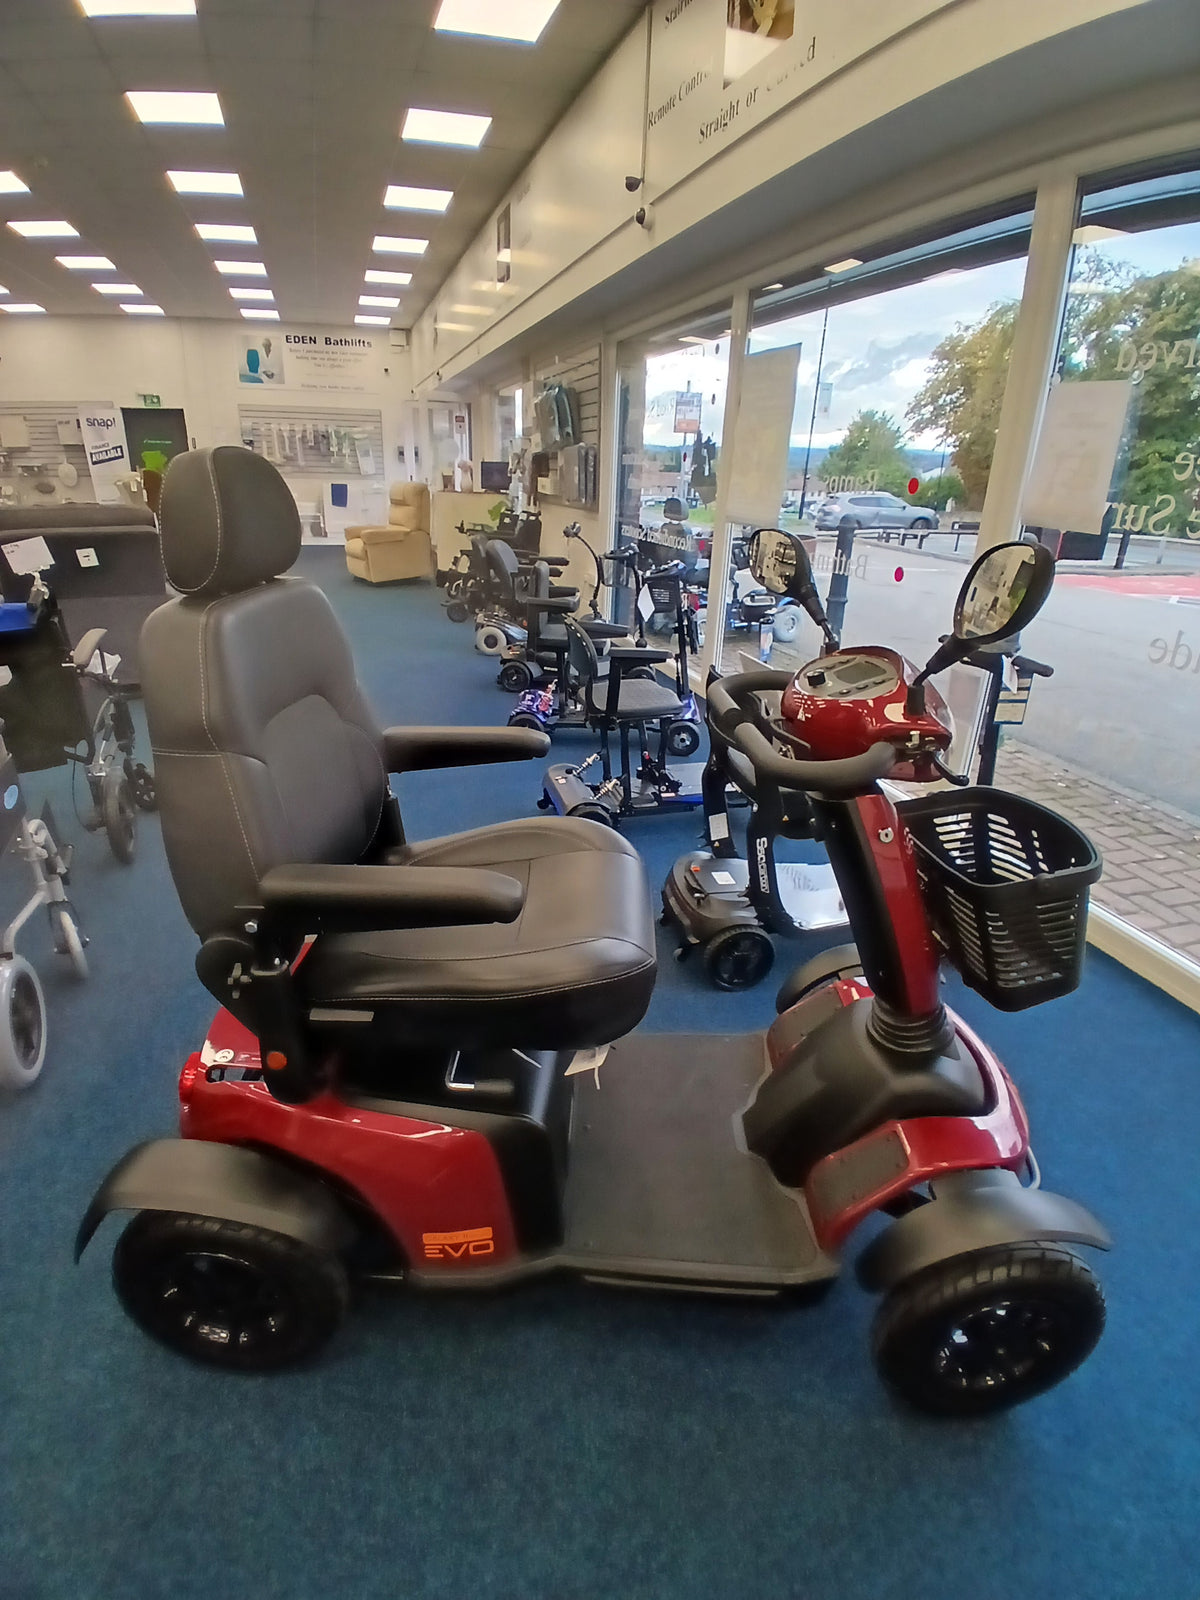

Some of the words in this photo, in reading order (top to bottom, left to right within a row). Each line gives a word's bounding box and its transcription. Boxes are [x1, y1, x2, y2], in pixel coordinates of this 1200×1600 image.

[648, 94, 677, 130] Remote
[698, 99, 740, 144] Straight
[745, 86, 760, 108] or
[285, 334, 317, 345] EDEN
[324, 336, 373, 349] Bathlifts
[424, 1239, 495, 1258] EVO
